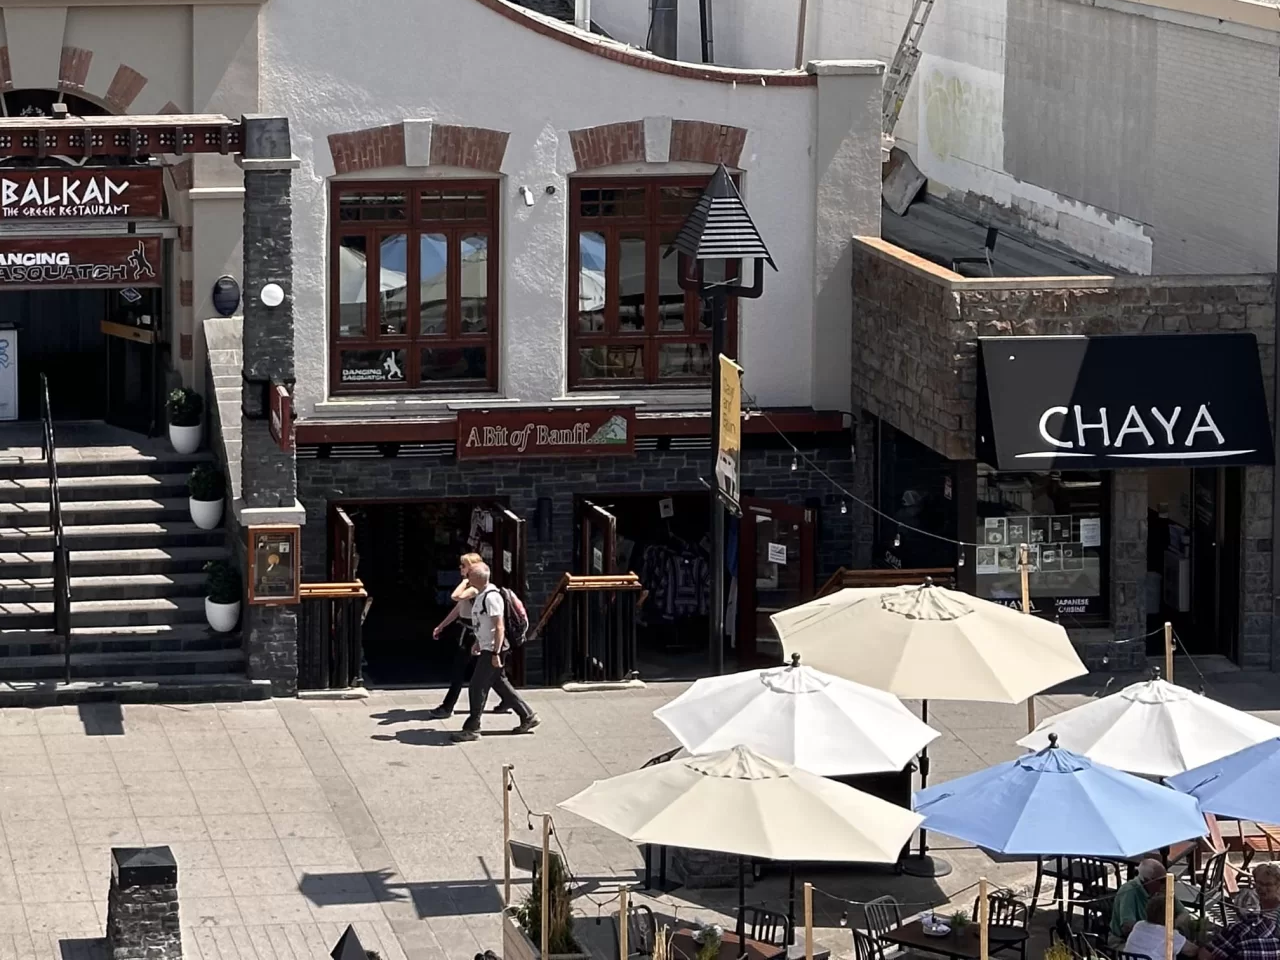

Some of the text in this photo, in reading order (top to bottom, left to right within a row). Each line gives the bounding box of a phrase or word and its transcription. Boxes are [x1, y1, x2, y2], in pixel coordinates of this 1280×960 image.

[1, 176, 130, 206] BALKAN
[2, 204, 130, 217] THE GREEK RESTAURANT
[466, 426, 482, 447] A
[483, 425, 508, 446] Bit
[510, 423, 534, 452] of
[1038, 404, 1225, 448] CHAYA
[1055, 598, 1089, 606] JAPANESE
